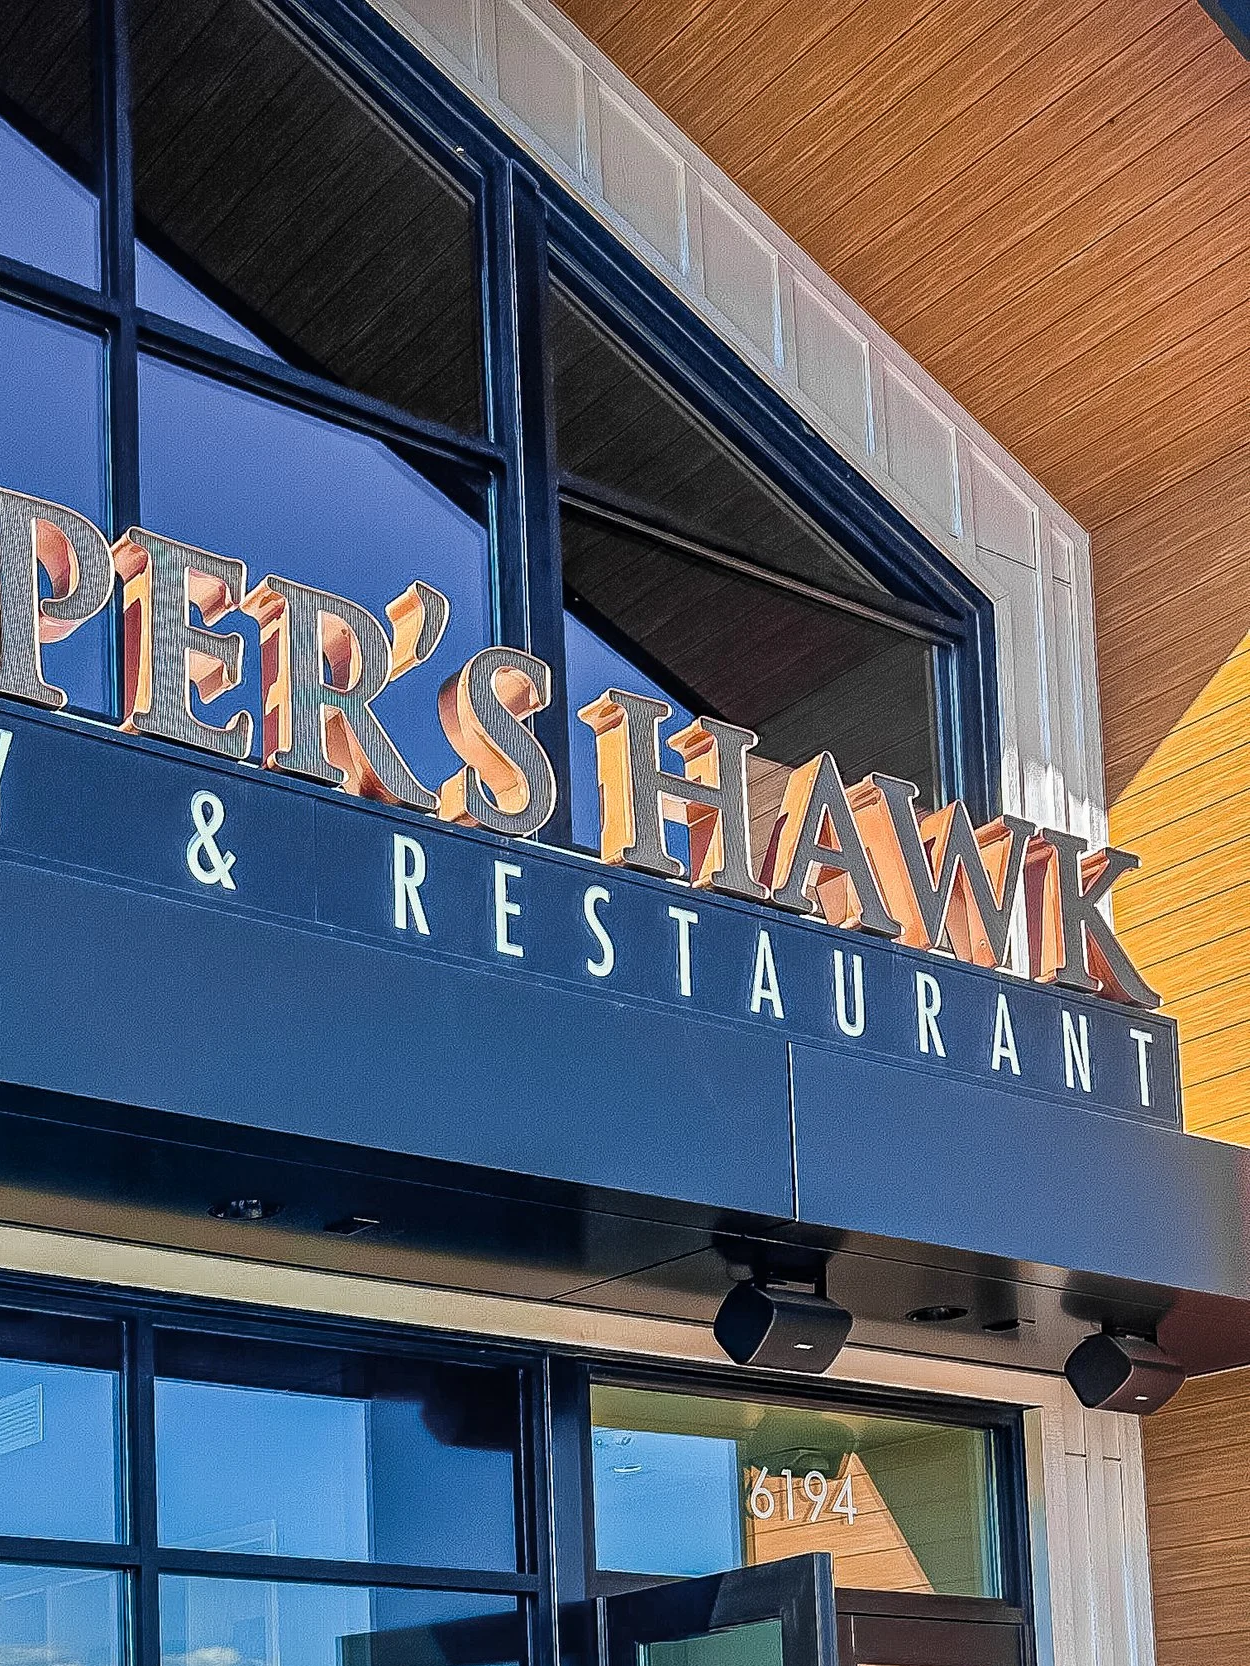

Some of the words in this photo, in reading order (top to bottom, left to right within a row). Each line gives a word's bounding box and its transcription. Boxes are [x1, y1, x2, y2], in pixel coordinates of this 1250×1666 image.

[185, 790, 236, 890] &
[392, 834, 1155, 1106] RESTAURANT
[578, 688, 1162, 1008] HAWK
[751, 1466, 858, 1525] 6194
